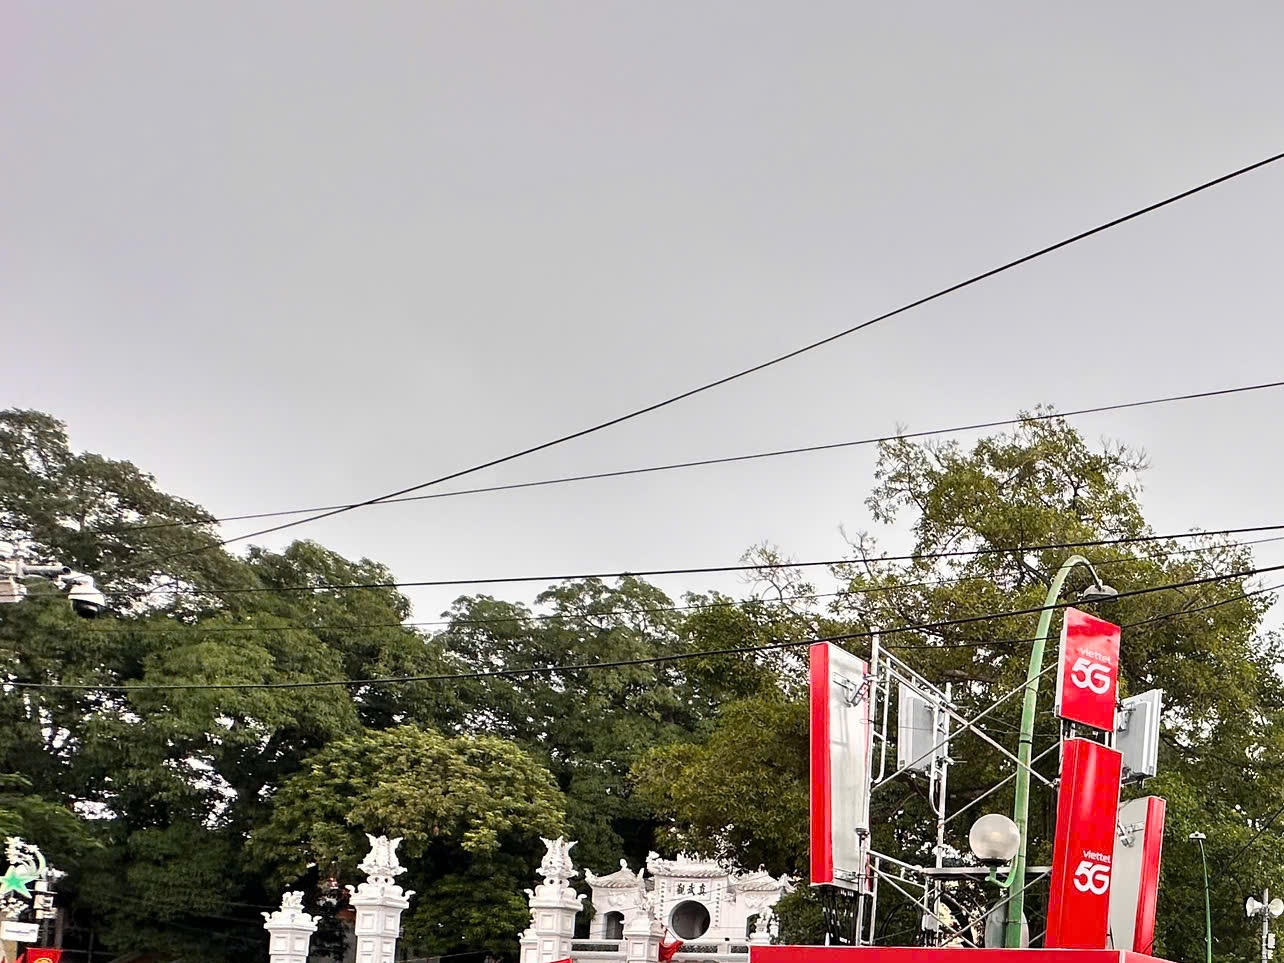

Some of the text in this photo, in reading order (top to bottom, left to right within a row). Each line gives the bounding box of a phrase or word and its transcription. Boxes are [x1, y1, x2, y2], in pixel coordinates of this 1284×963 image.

[1078, 647, 1111, 665] viettel
[1071, 657, 1111, 694] 5G
[1083, 849, 1111, 864] viettel
[1073, 860, 1111, 895] 5G
